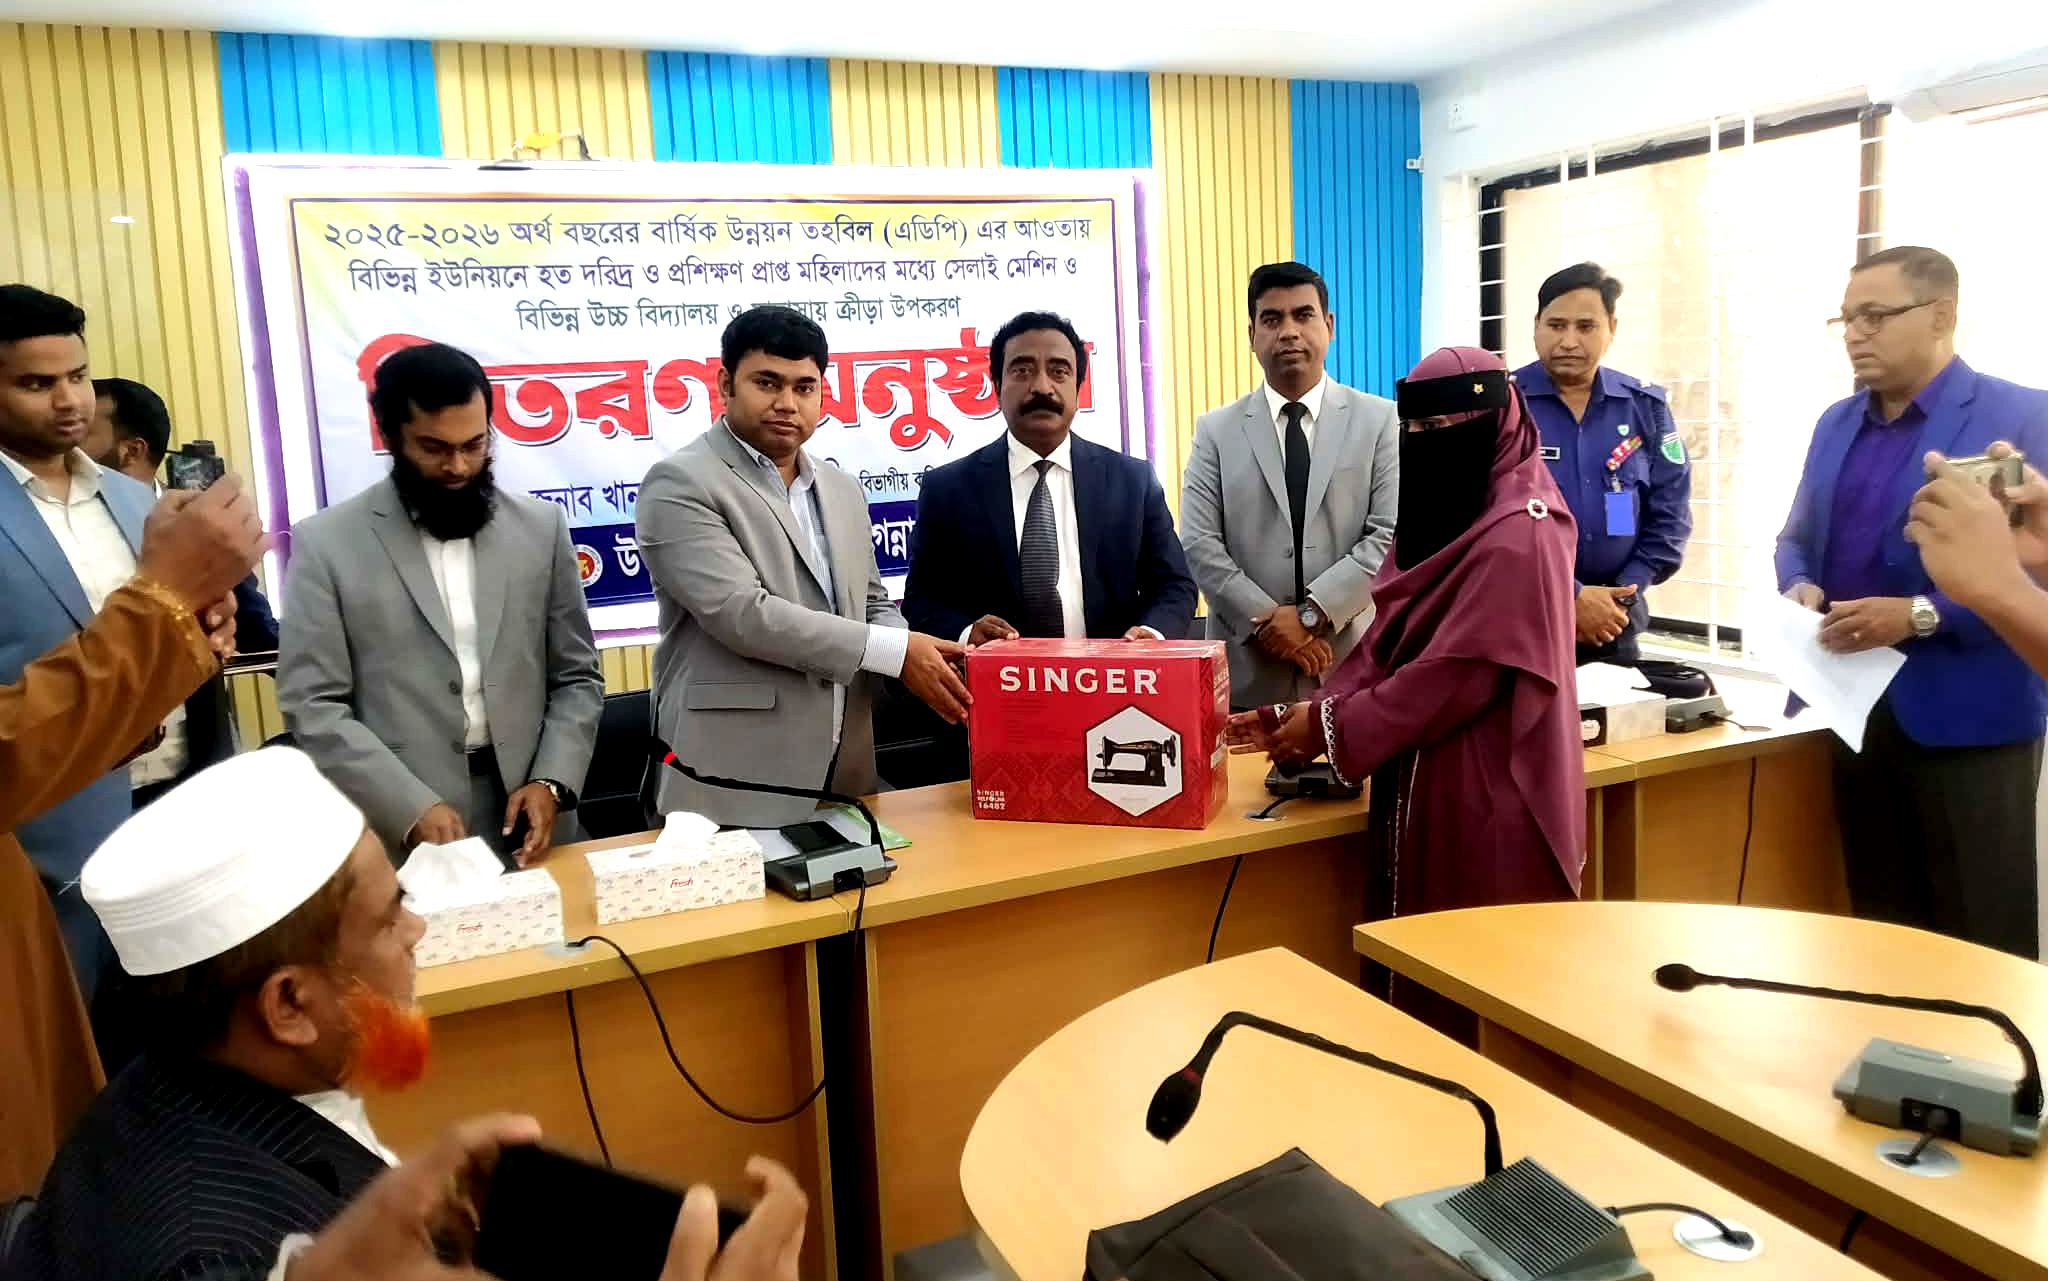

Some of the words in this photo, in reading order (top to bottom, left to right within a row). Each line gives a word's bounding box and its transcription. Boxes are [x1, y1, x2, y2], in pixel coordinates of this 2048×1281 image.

[325, 223, 499, 250] ২০২৫-২০২৬
[508, 213, 553, 245] অর্থ
[560, 221, 640, 247] বছরের
[648, 213, 717, 245] বার্ষিক
[725, 214, 793, 248] উন্নয়ন
[800, 213, 874, 244] তহবিল
[883, 213, 968, 248] (এডিপি)
[977, 219, 1006, 240] এর
[1014, 217, 1092, 241] আওতায়
[347, 258, 418, 295] বিভিন্ন
[424, 256, 529, 292] ইউনিয়নে
[535, 263, 573, 290] হত
[581, 255, 635, 289] দরিদ্র
[643, 264, 659, 284] ও
[667, 254, 744, 286] প্রশিক্ষণ
[752, 260, 791, 284] প্রাপ্ত
[796, 253, 887, 284] মহিলাদের
[893, 260, 936, 281] মধ্যে
[944, 252, 999, 281] সেলাই
[1006, 250, 1057, 278] মেশিন
[1063, 257, 1077, 275] ও
[515, 299, 581, 333] বিভিন্ন
[587, 299, 630, 327] উচ্চ
[638, 298, 719, 327] বিদ্যালয়
[834, 291, 884, 325] ক্রীড়া
[889, 292, 961, 318] উপকরণ
[1000, 666, 1159, 695] SINGER
[669, 877, 694, 888] Fresh
